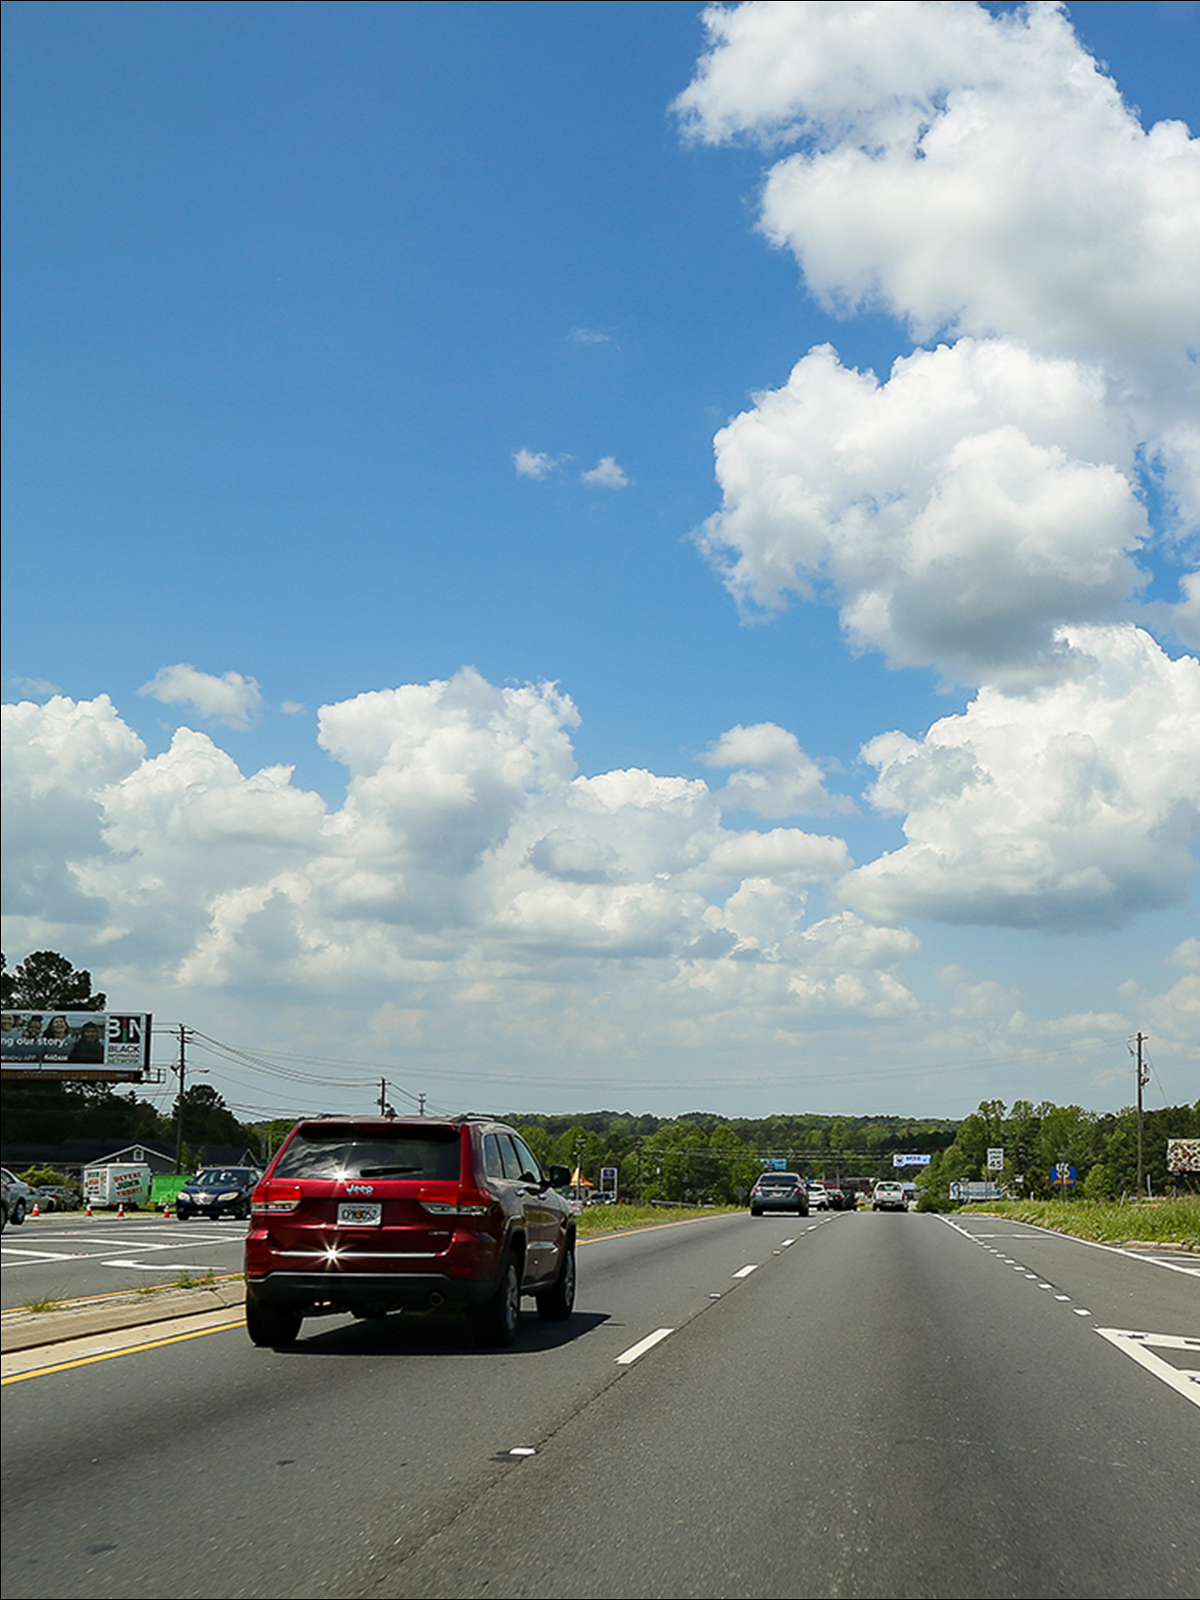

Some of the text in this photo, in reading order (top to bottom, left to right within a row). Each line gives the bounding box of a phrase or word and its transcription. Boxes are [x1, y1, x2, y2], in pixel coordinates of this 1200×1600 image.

[16, 1037, 35, 1046] our
[37, 1036, 68, 1048] story.
[108, 1045, 140, 1053] BLACK
[989, 1160, 1003, 1168] 45
[345, 1183, 374, 1195] Jeep
